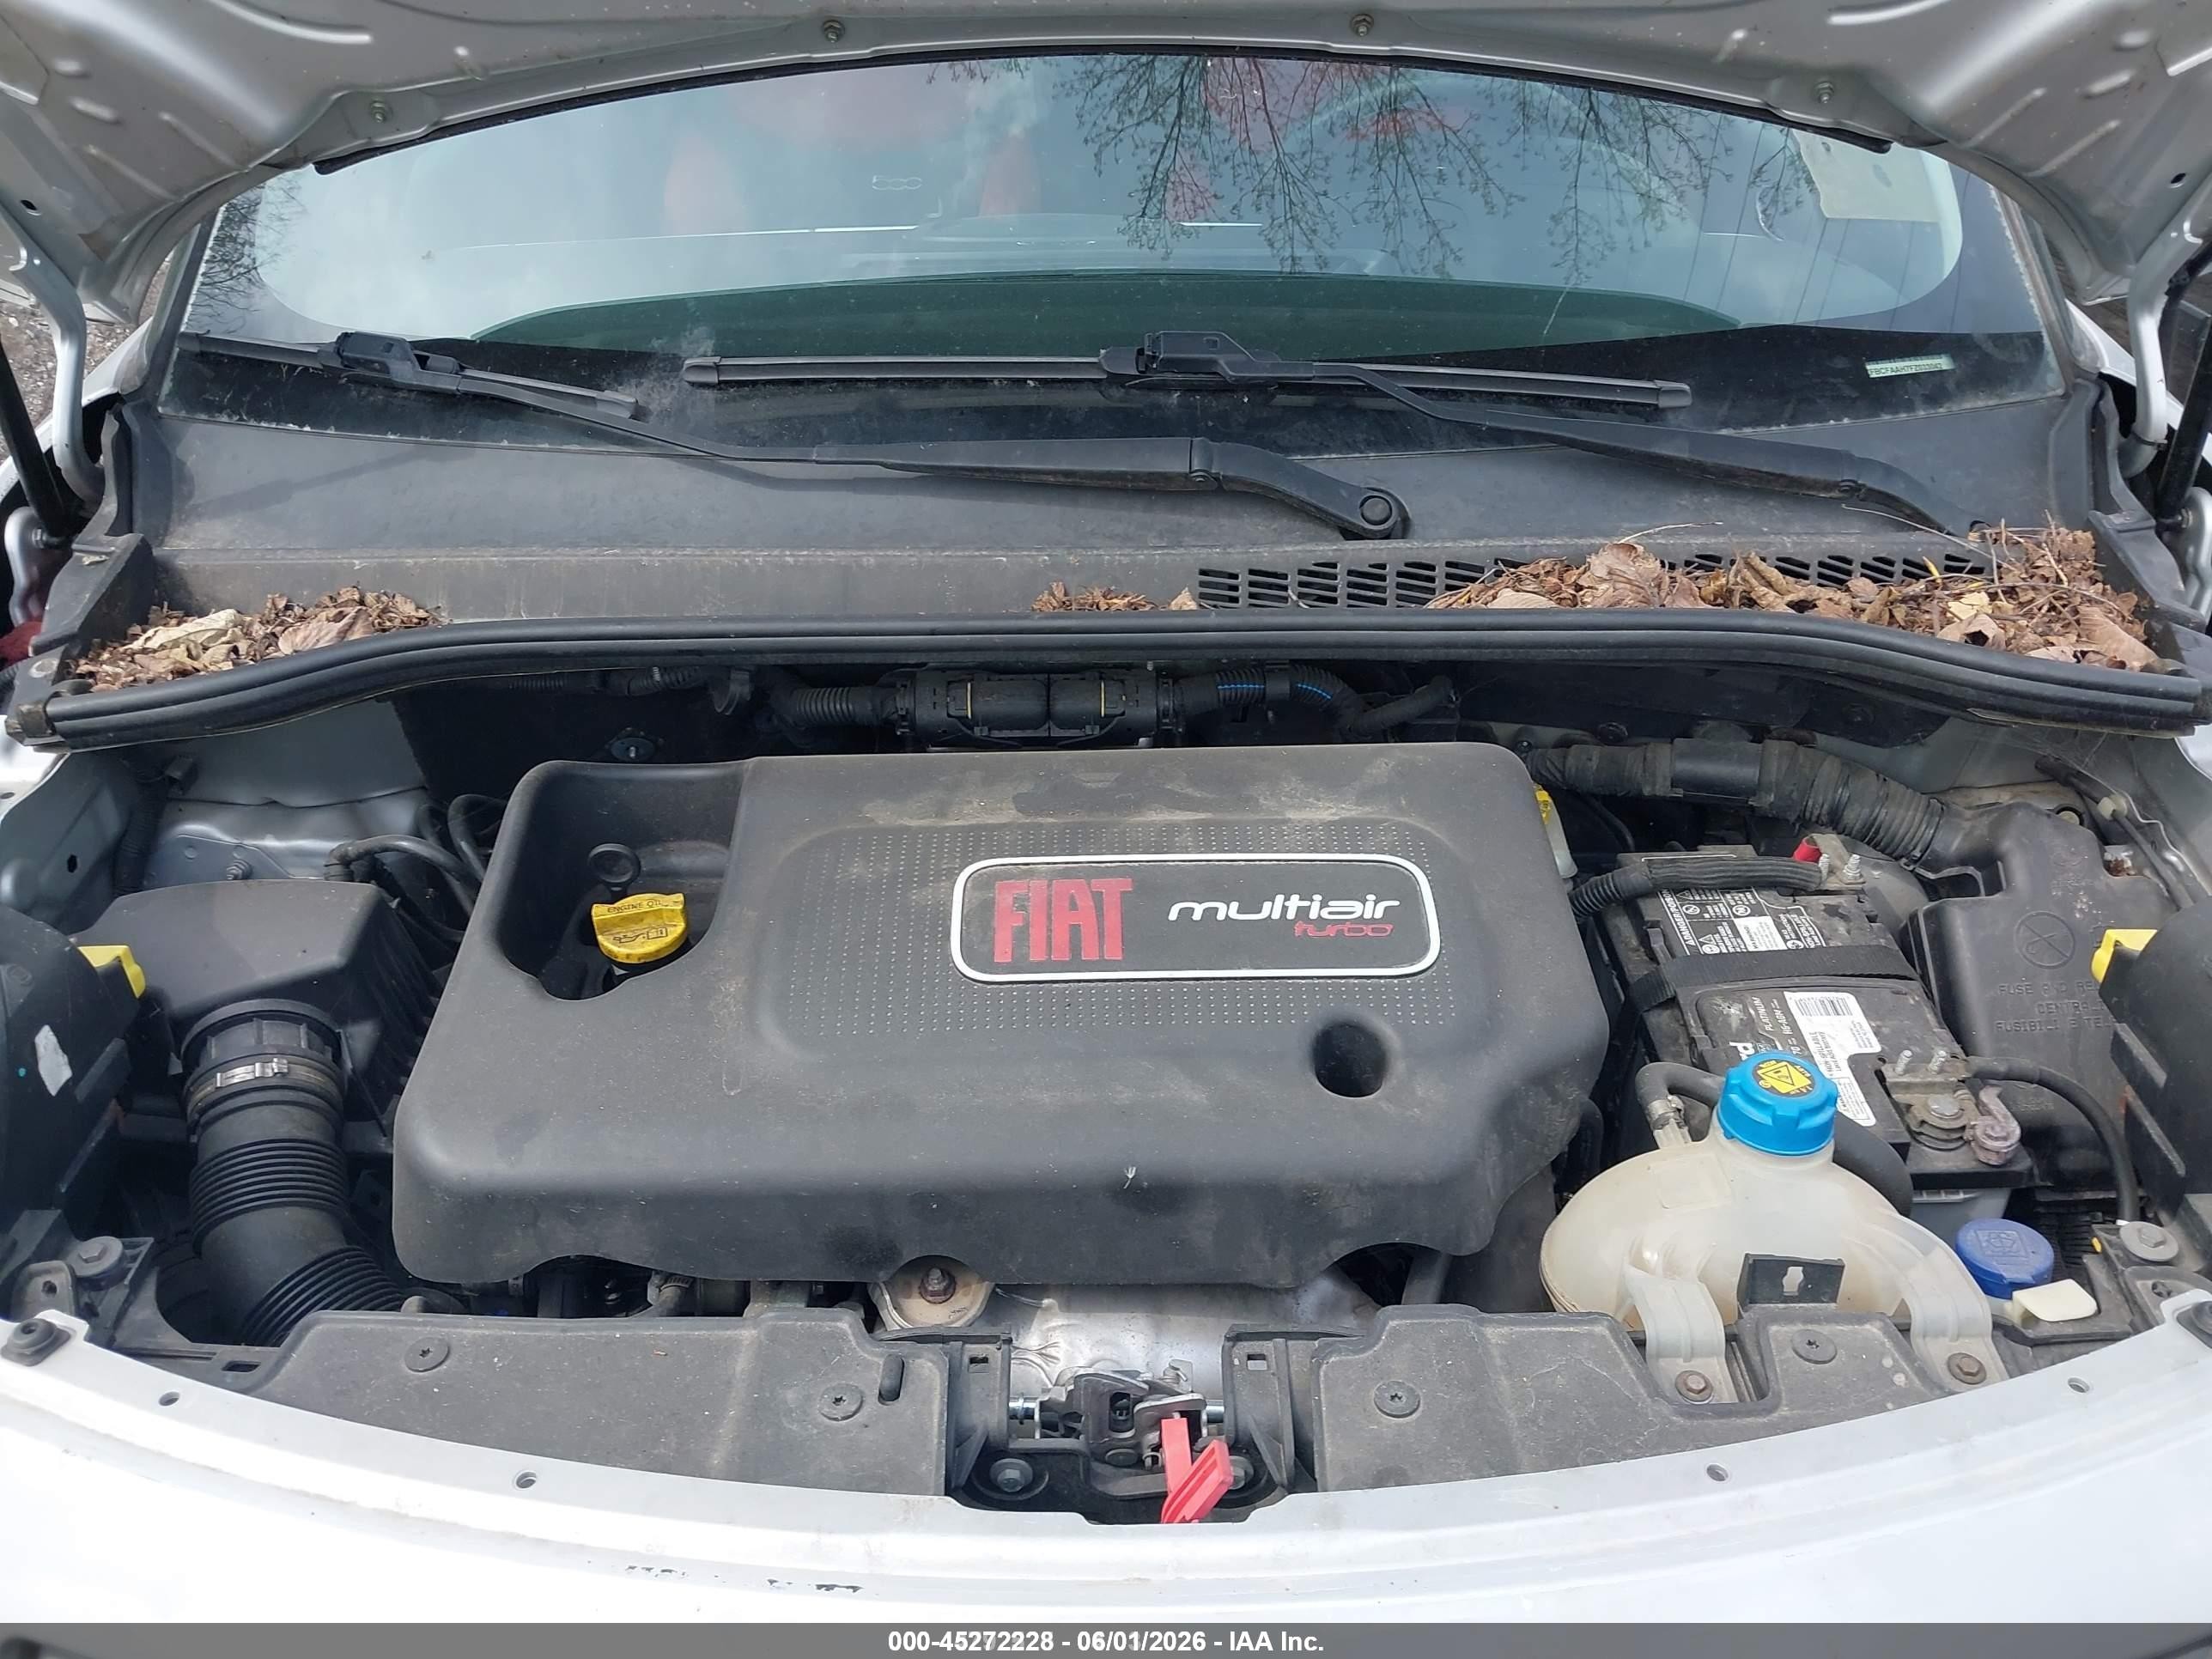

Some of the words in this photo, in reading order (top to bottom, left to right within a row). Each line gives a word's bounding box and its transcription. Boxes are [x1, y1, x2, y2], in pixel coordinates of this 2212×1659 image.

[607, 902, 644, 913] ENGINE
[994, 878, 1133, 963] FIAT
[1168, 894, 1400, 921] multiair
[1294, 921, 1394, 938] turbo
[1998, 981, 2033, 994] FUSE
[1752, 996, 1774, 1030] PLATINUM
